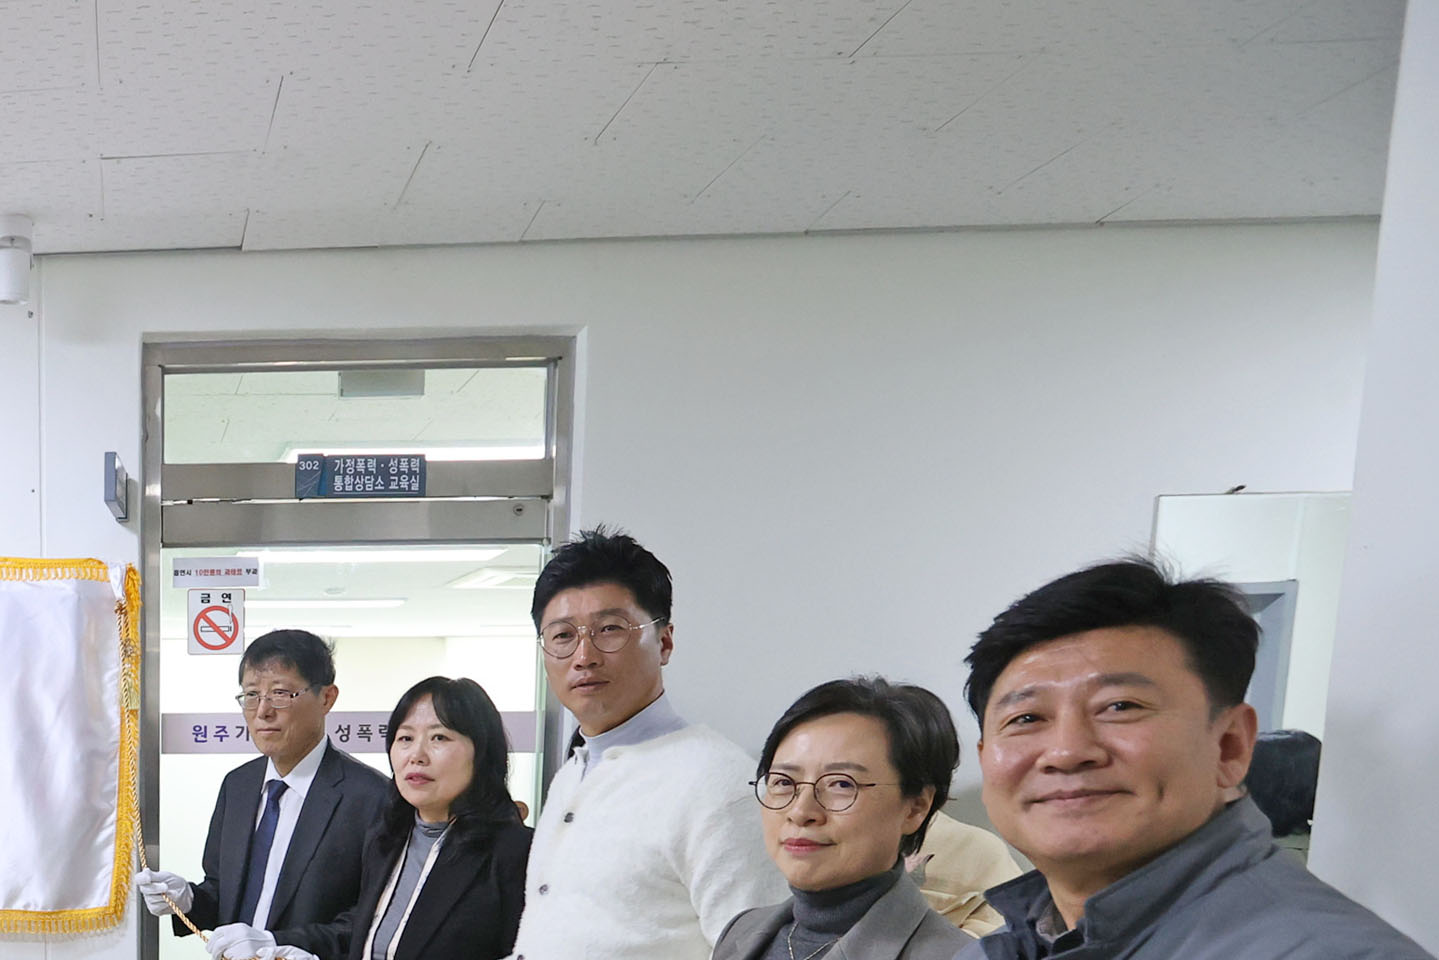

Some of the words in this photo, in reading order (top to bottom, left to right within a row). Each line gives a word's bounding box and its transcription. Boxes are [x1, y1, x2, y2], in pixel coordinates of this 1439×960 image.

[299, 460, 320, 471] 302
[332, 475, 385, 492] 통합상담소
[388, 474, 420, 491] 교육실
